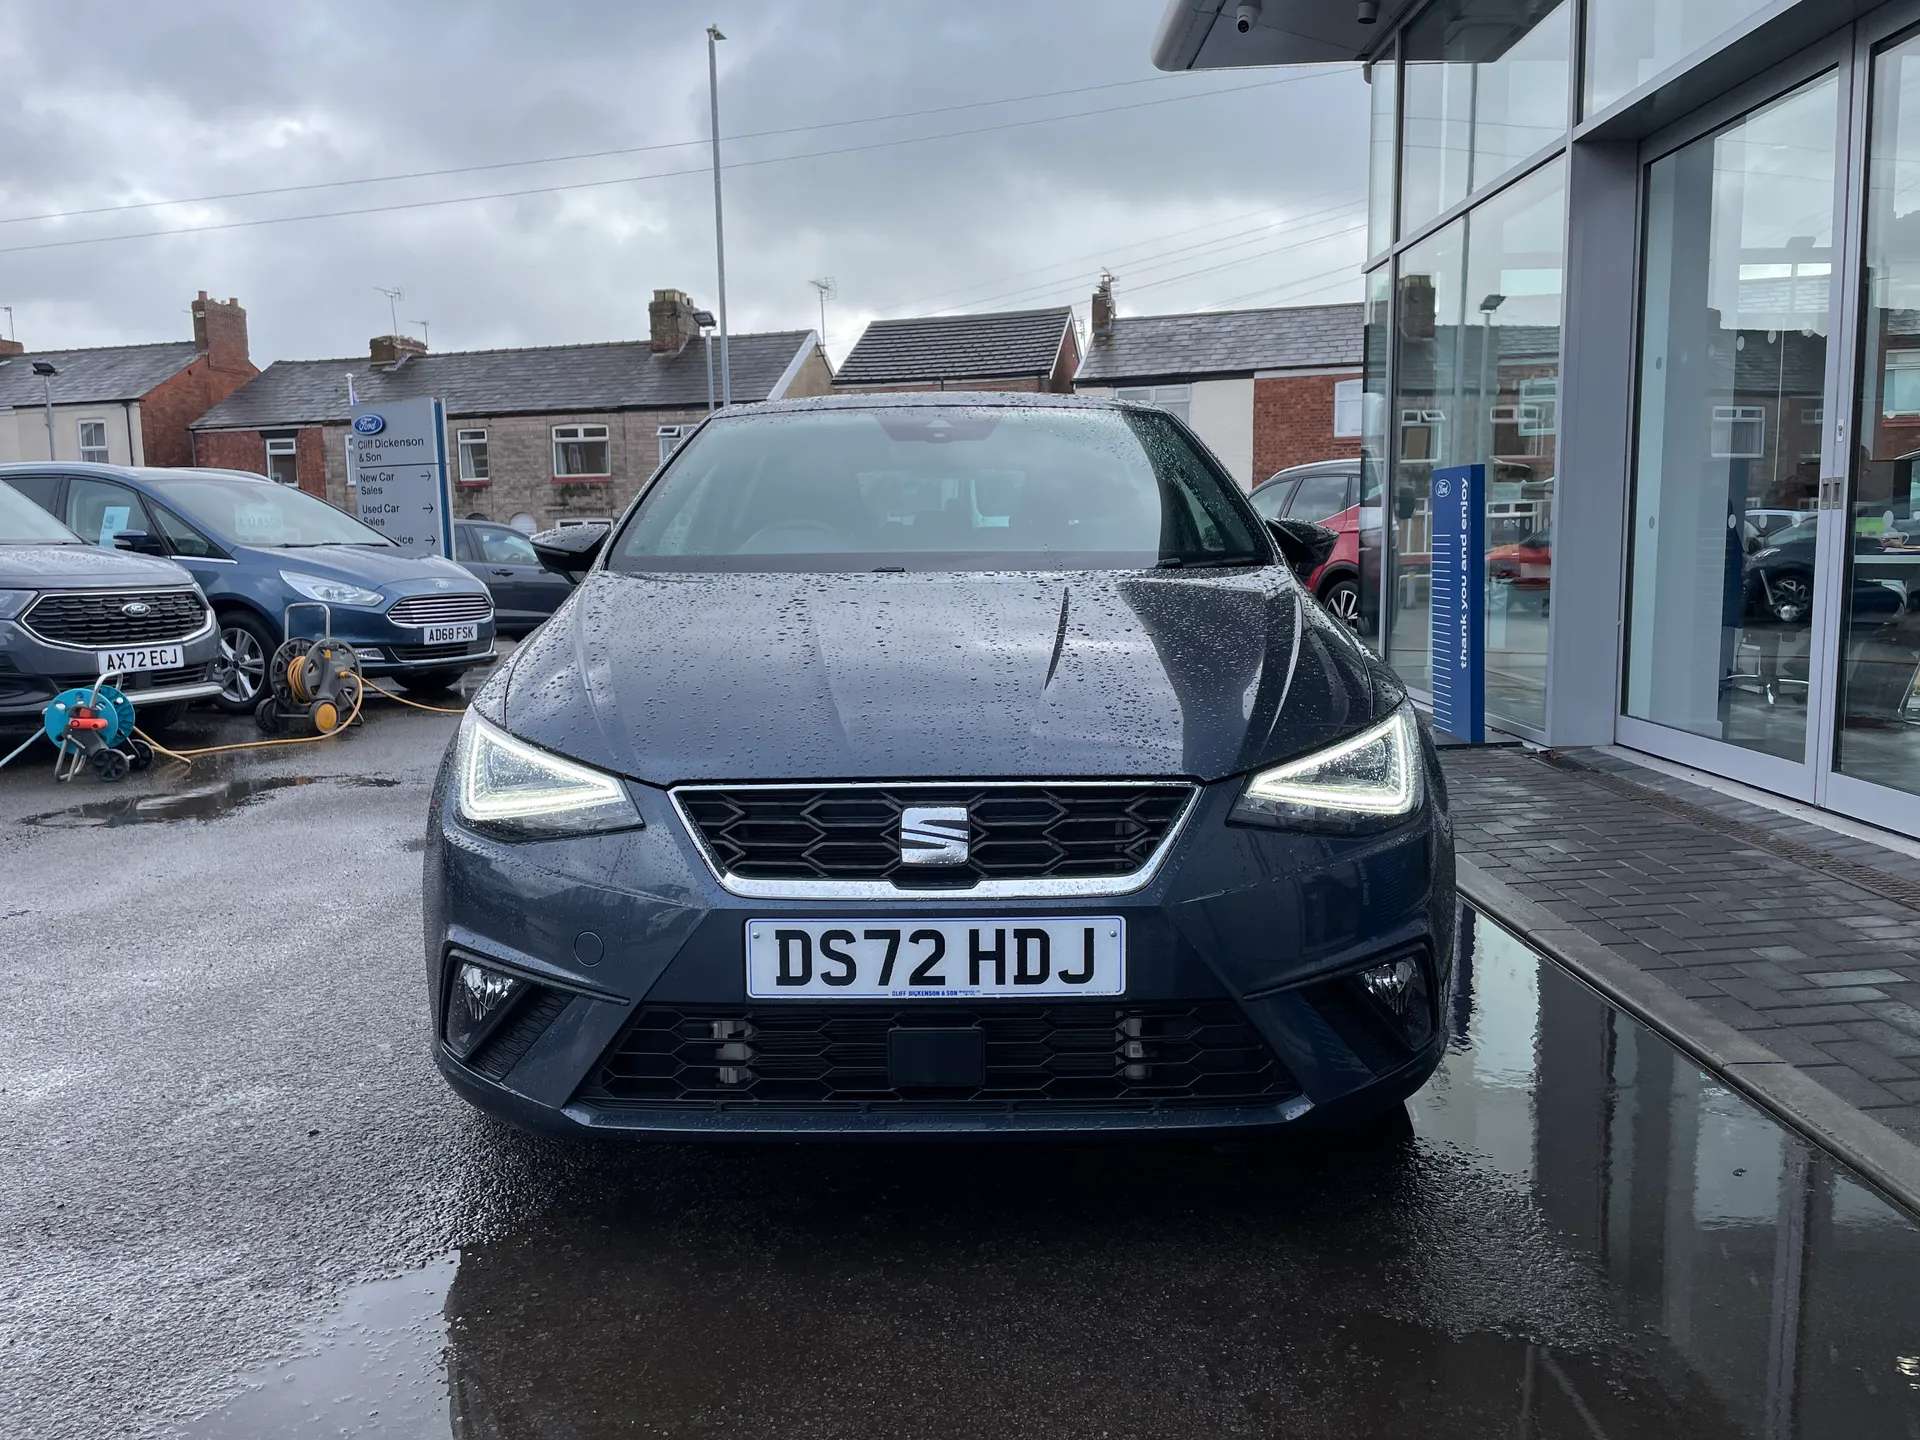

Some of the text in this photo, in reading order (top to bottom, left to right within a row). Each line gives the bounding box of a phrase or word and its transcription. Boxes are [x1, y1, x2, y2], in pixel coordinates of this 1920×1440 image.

[358, 418, 376, 431] Ford
[358, 437, 424, 450] Cliff Dickenson
[358, 453, 382, 462] & Son
[360, 472, 394, 483] New Car
[361, 486, 383, 496] Sales
[362, 504, 400, 514] Used Car
[1460, 477, 1469, 530] enjoy
[363, 517, 385, 526] Sales
[1461, 574, 1469, 610] you
[428, 626, 474, 642] AD68 FSK
[106, 648, 178, 671] AX72 ECJ
[774, 927, 1095, 987] DS72 HDJ
